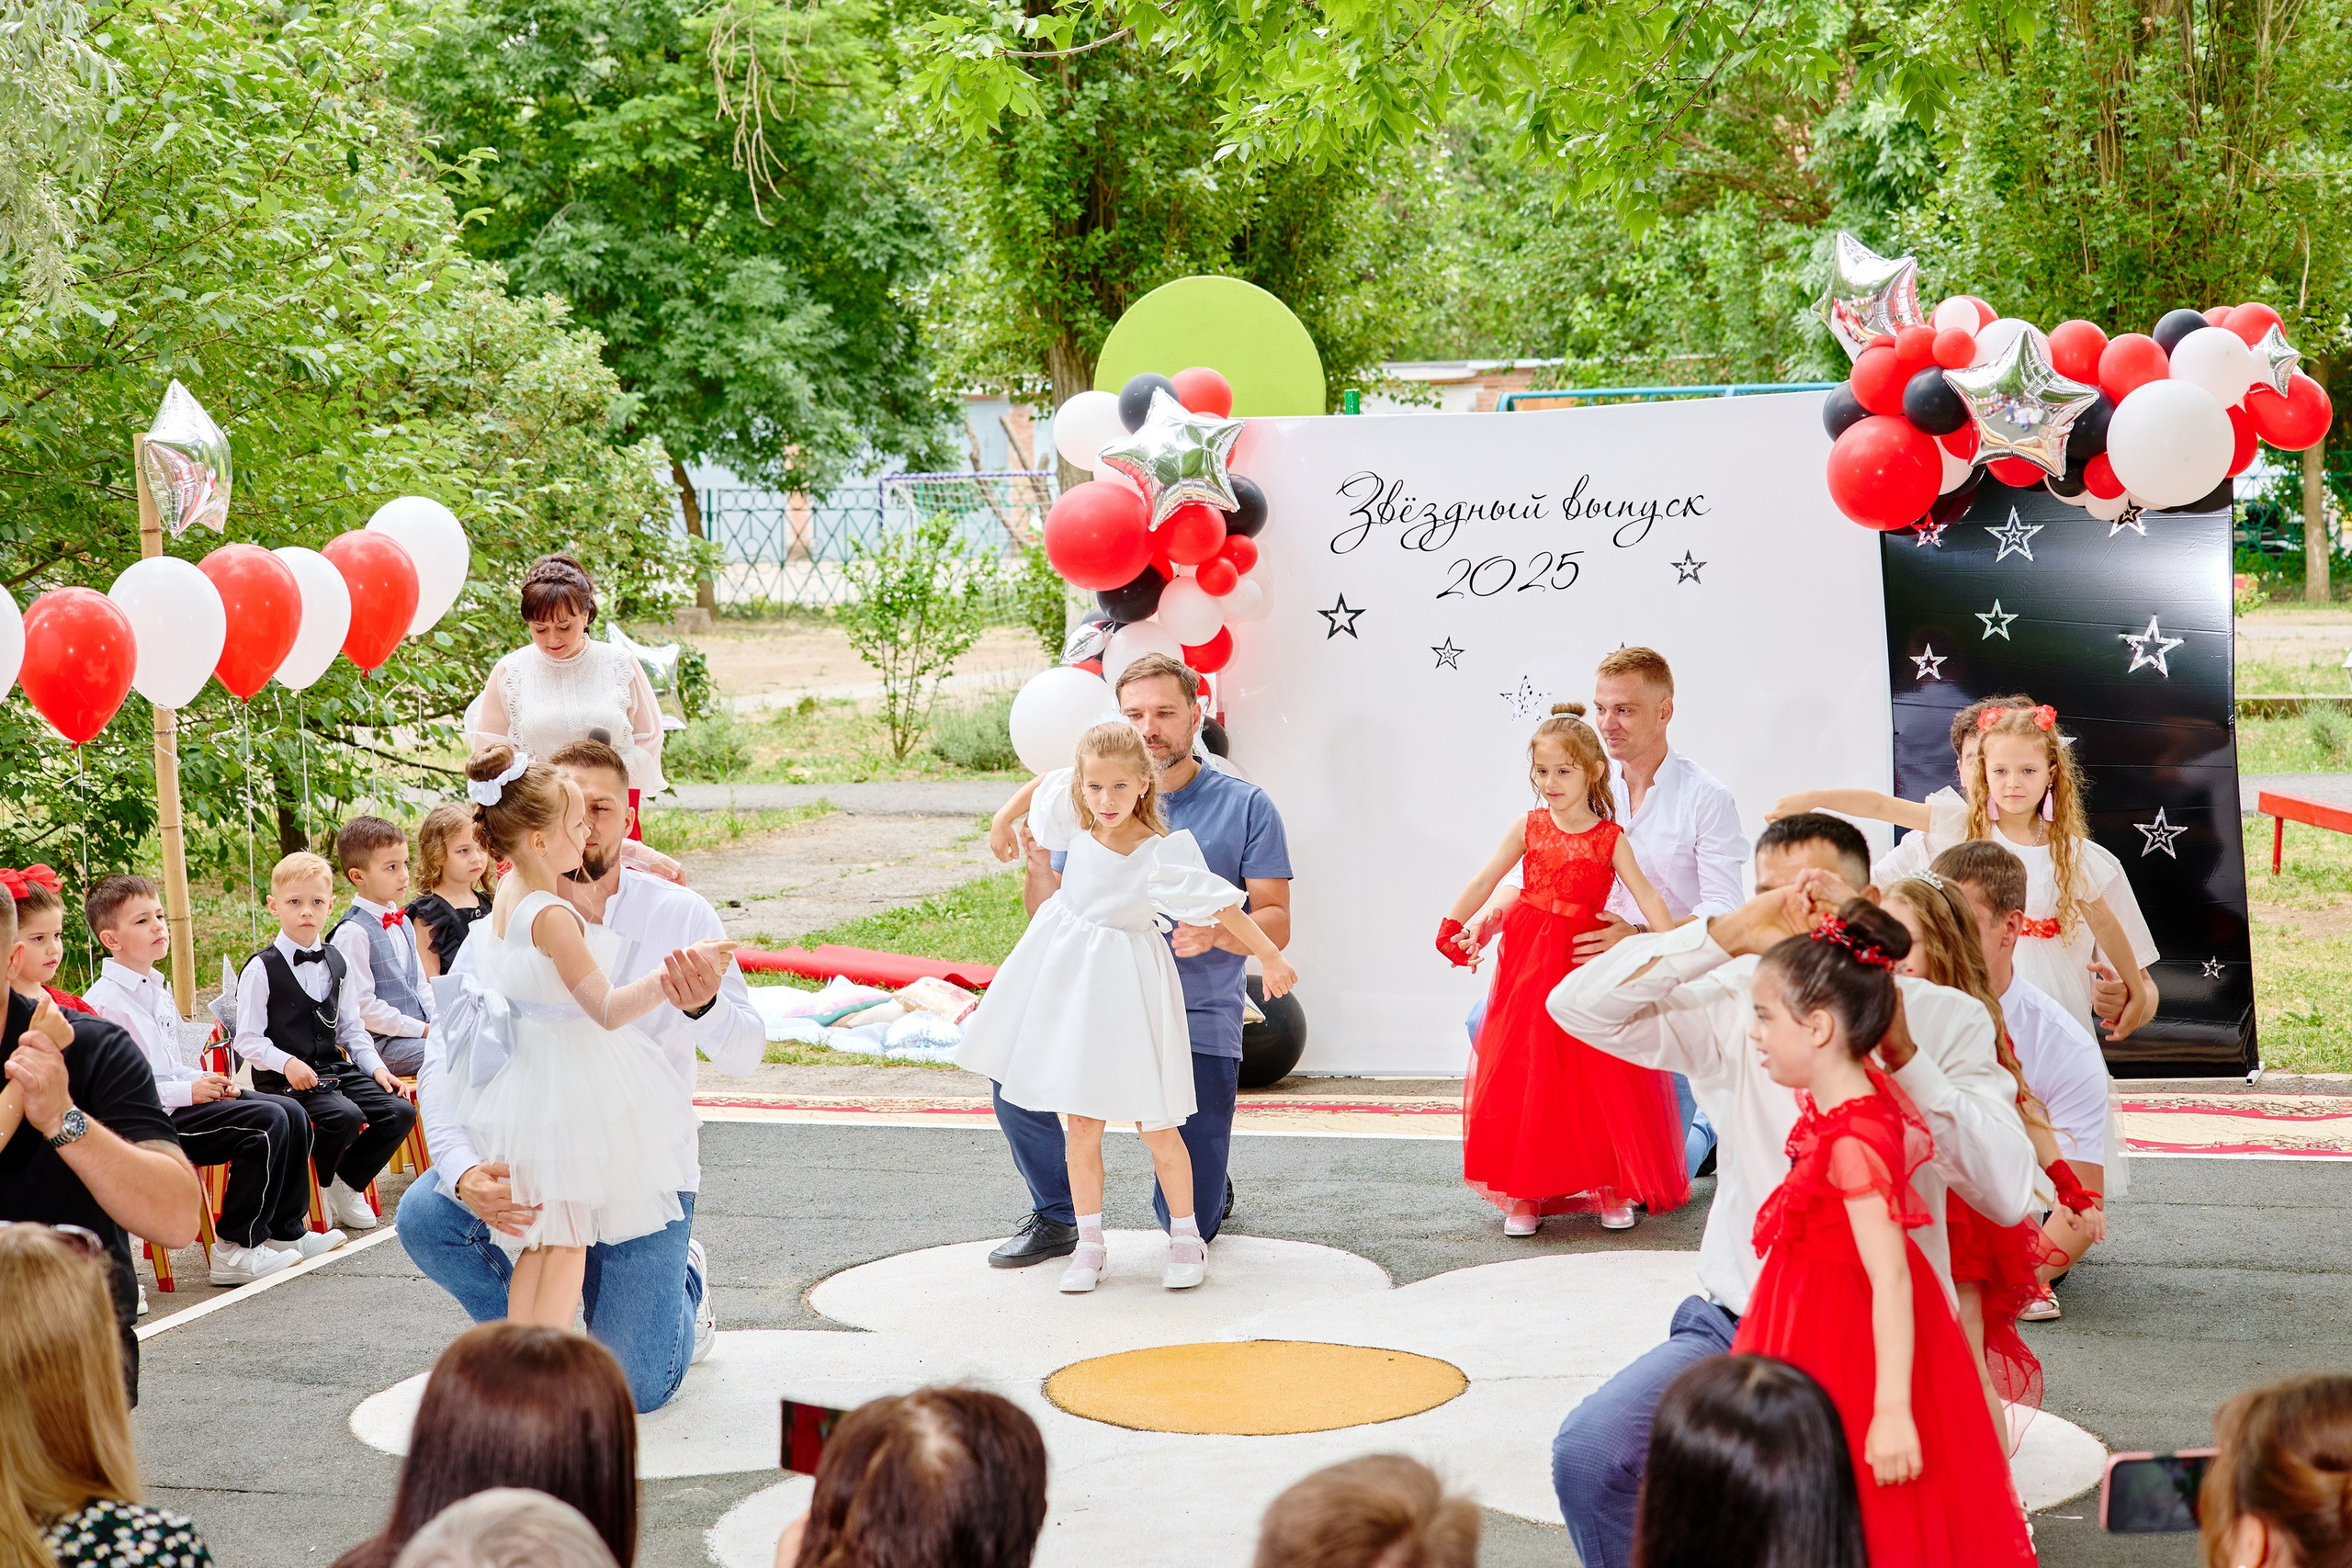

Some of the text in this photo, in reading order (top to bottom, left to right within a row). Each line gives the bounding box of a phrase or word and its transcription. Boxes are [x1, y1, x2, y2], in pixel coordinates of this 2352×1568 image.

[1330, 471, 1712, 555] Звёздный выпуск
[1436, 551, 1585, 600] 2025
